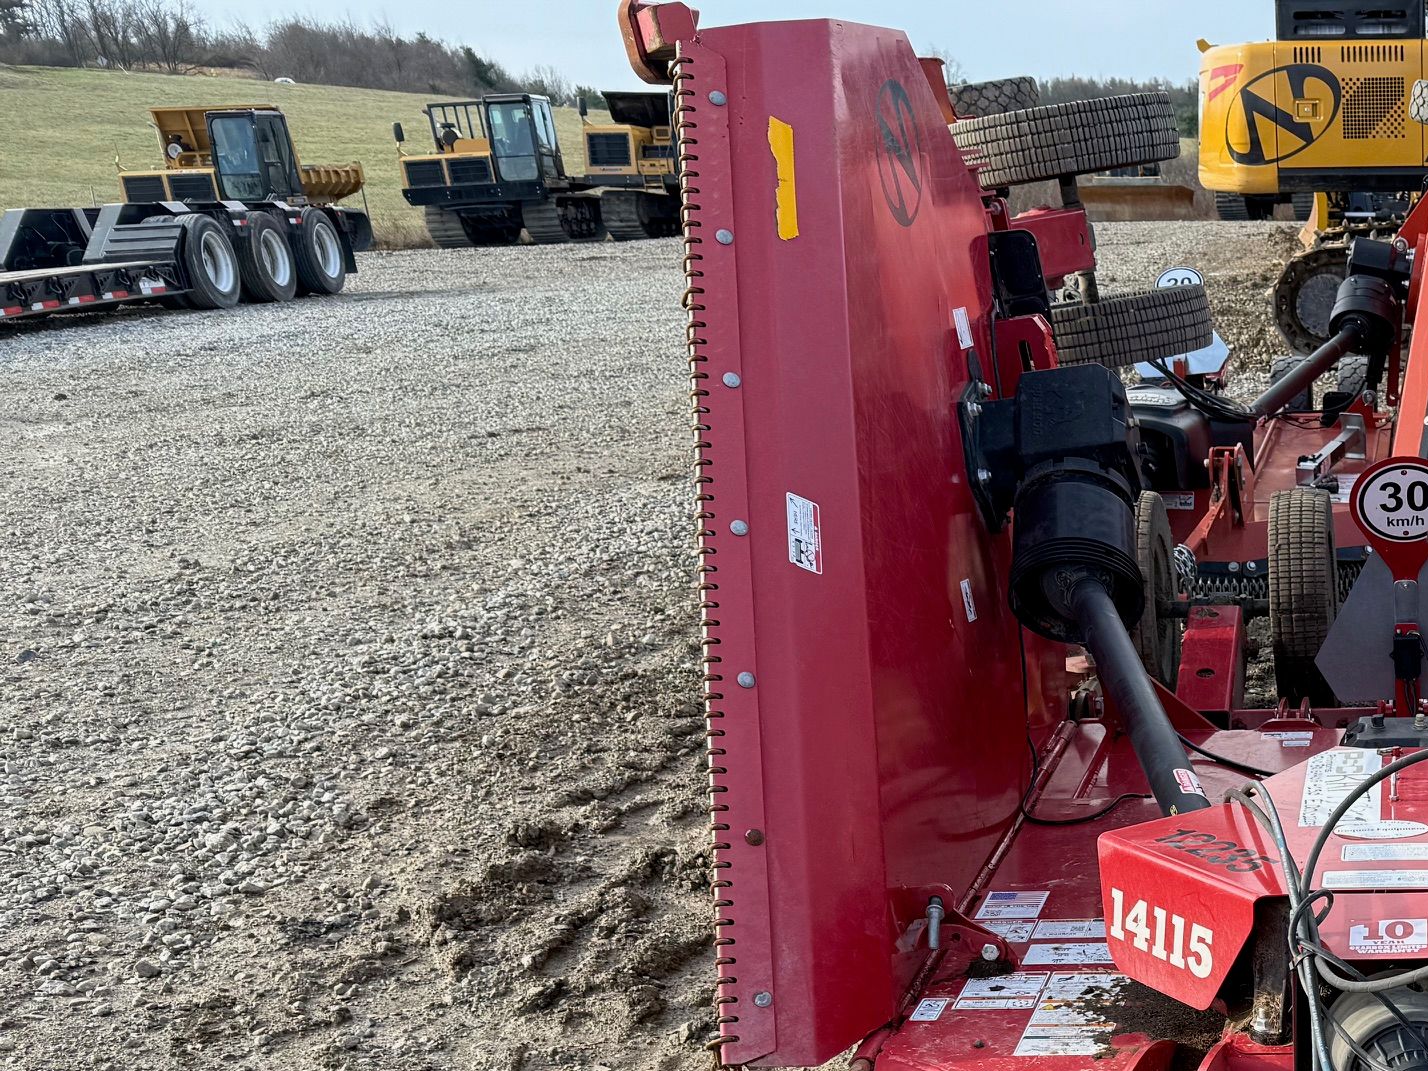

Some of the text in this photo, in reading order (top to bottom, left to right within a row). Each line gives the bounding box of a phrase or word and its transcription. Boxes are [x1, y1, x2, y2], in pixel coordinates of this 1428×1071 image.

[1386, 515, 1425, 527] km/h
[1110, 887, 1213, 979] 14115
[1363, 920, 1414, 941] 10
